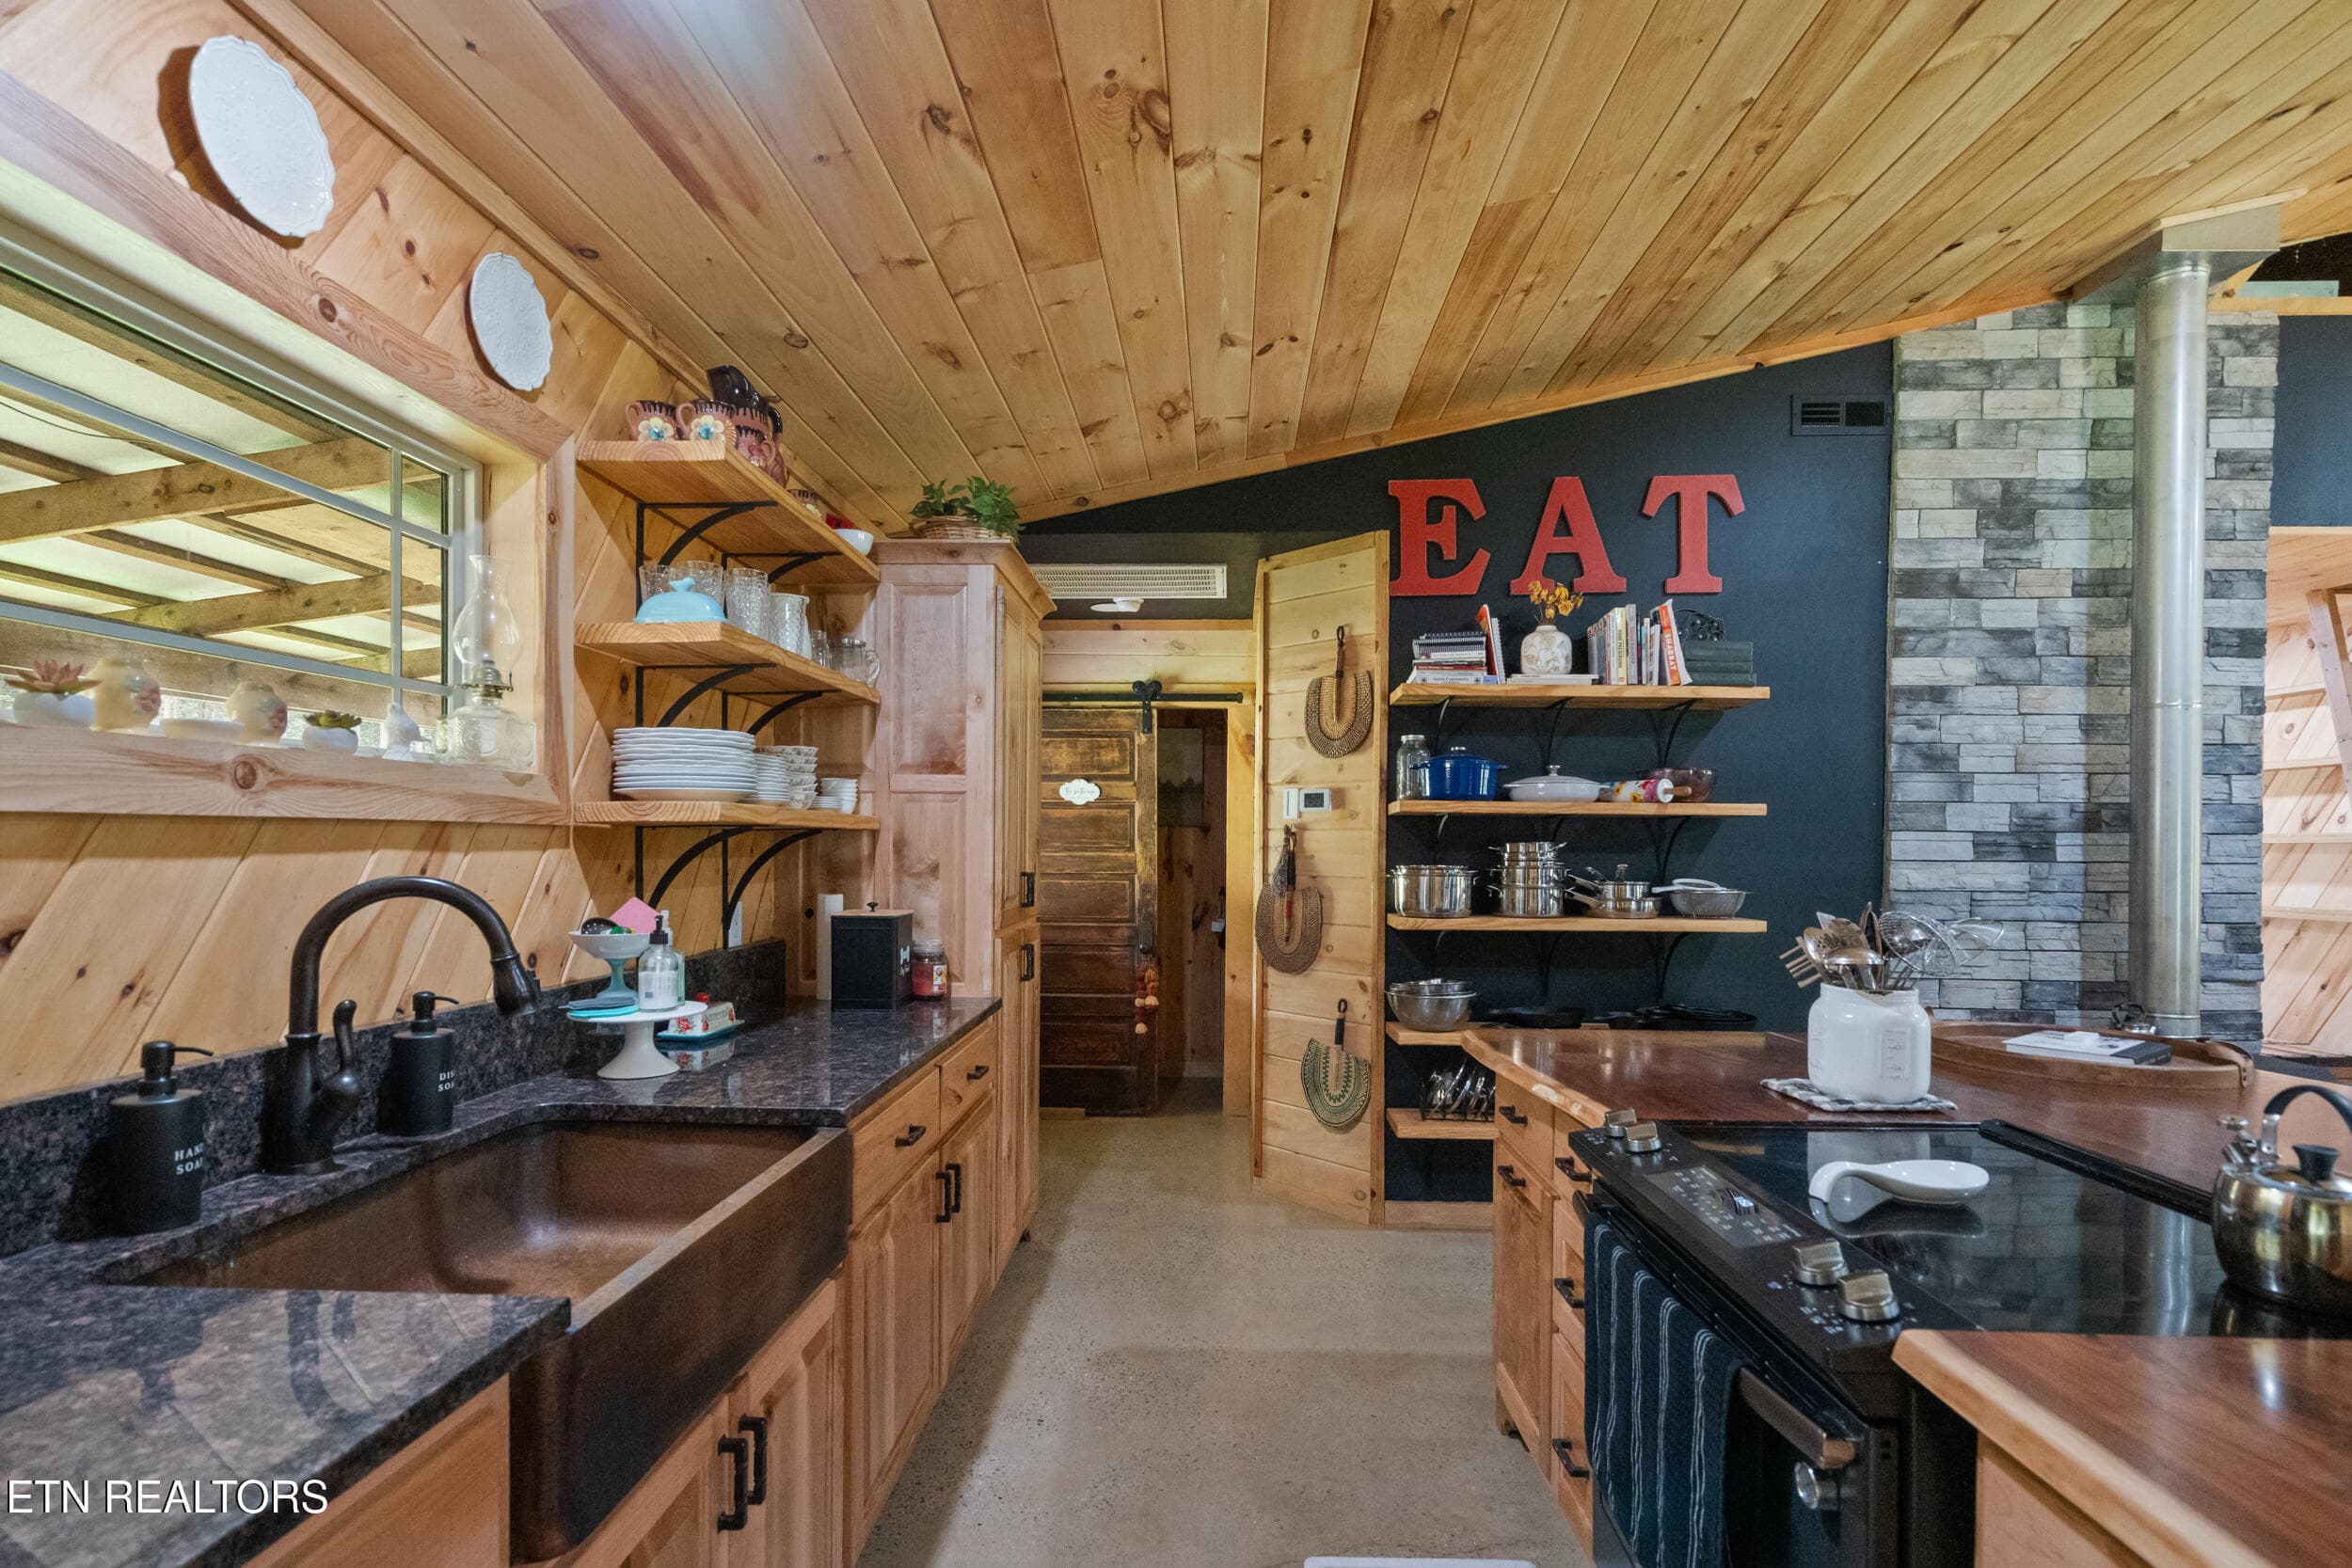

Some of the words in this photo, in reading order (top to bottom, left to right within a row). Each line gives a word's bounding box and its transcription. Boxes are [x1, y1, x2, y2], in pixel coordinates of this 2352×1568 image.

[1388, 474, 1746, 596] EAT
[438, 1069, 456, 1082] DIS
[174, 1143, 204, 1162] HAN
